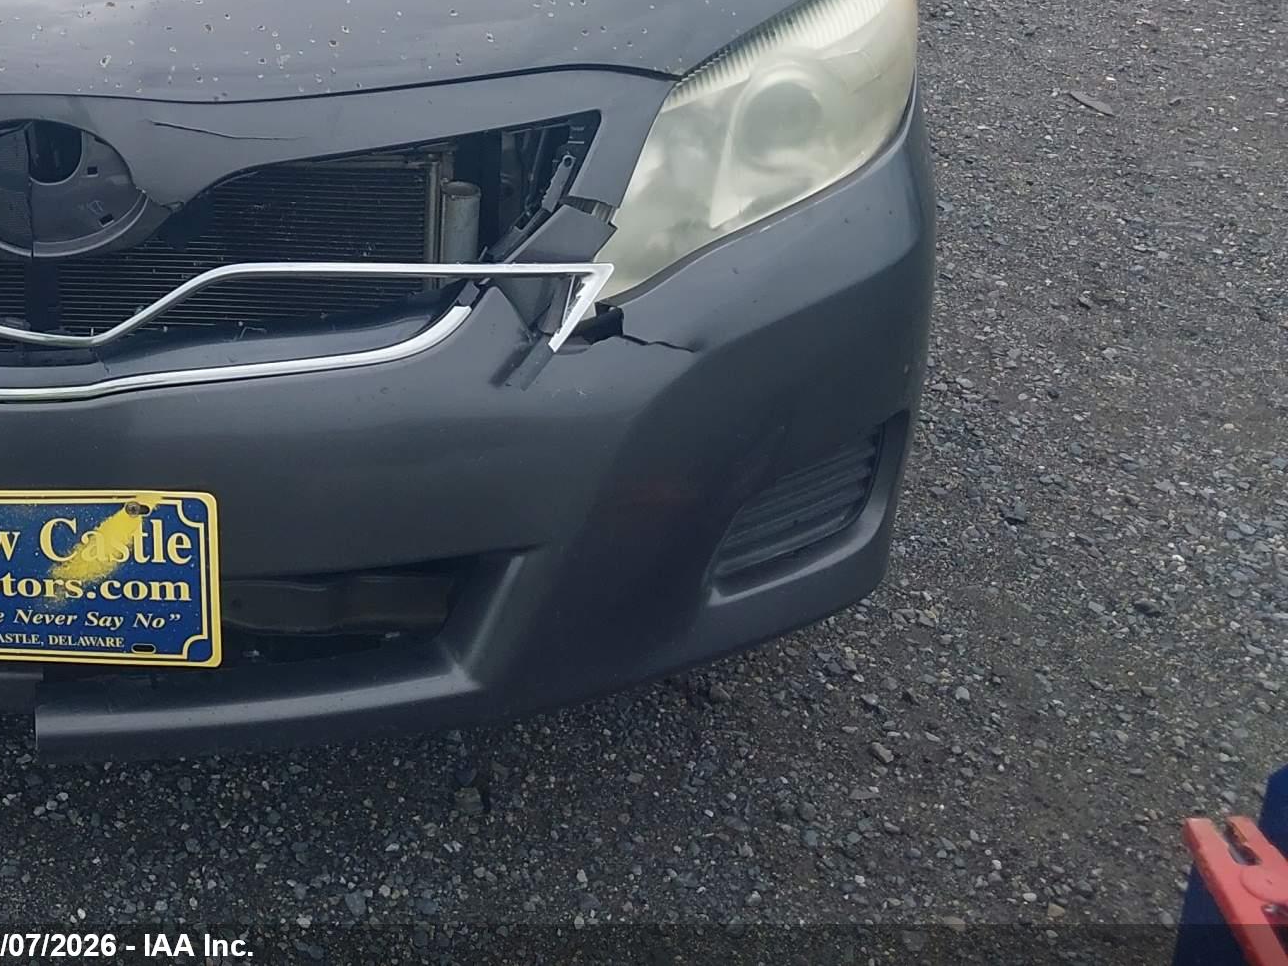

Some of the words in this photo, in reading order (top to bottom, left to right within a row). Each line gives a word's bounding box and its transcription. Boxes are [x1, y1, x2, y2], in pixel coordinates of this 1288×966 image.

[39, 517, 192, 565] Castle
[13, 609, 78, 626] Never
[84, 611, 124, 631] Say
[48, 634, 125, 649] DELAWARE
